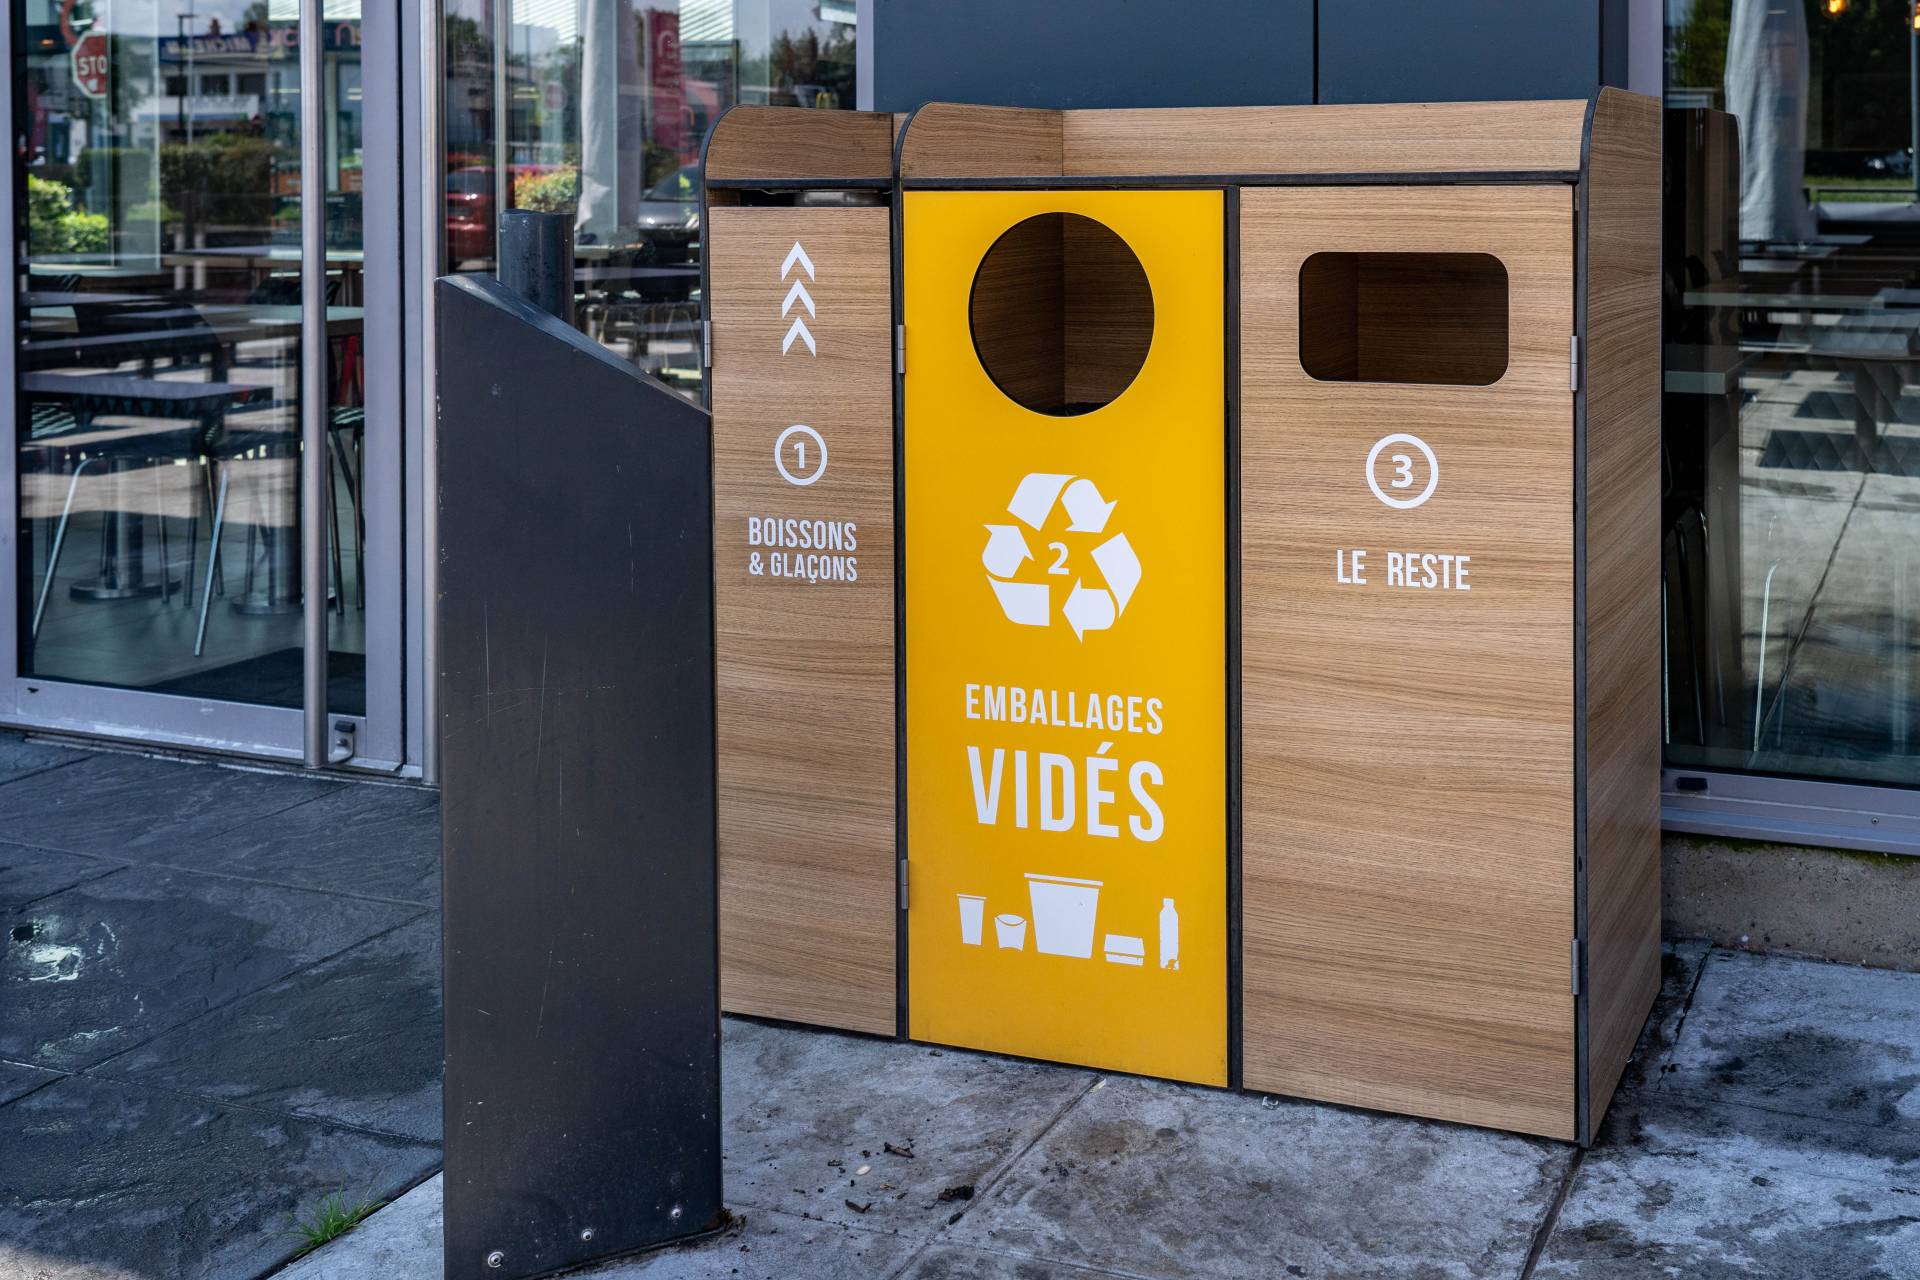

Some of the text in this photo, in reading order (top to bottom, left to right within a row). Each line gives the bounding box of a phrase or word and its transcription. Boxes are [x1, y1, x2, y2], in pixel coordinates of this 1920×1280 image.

[793, 442, 805, 469] 1
[1391, 454, 1414, 488] 3
[748, 516, 857, 551] BOISSONS
[749, 551, 858, 584] & GLAÇONS
[1047, 541, 1070, 575] 2
[1336, 549, 1471, 590] LE RESTE
[965, 683, 1163, 735] EMBALLAGES
[966, 741, 1165, 842] VIDÉS
